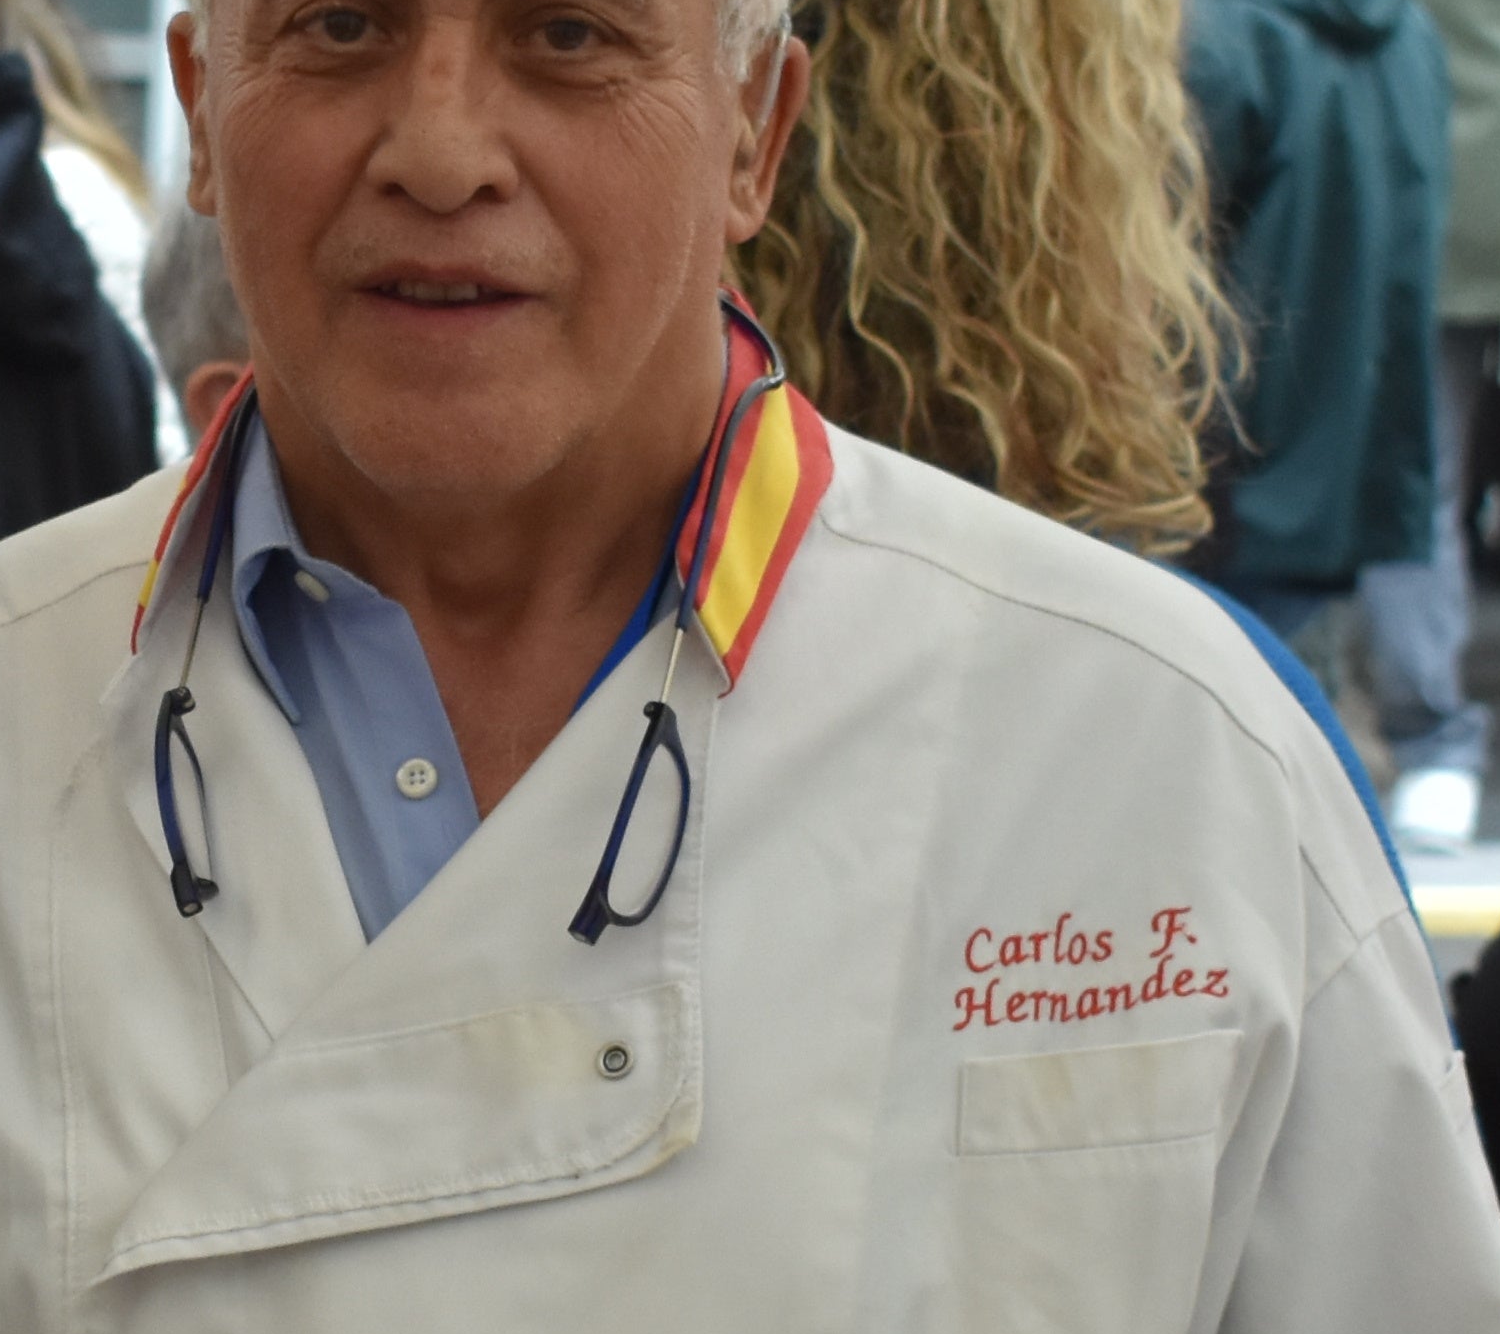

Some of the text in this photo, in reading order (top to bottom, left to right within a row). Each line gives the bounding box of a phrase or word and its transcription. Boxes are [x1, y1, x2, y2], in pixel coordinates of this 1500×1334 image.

[964, 906, 1198, 974] Carlos F.
[953, 953, 1229, 1033] Hernandez
